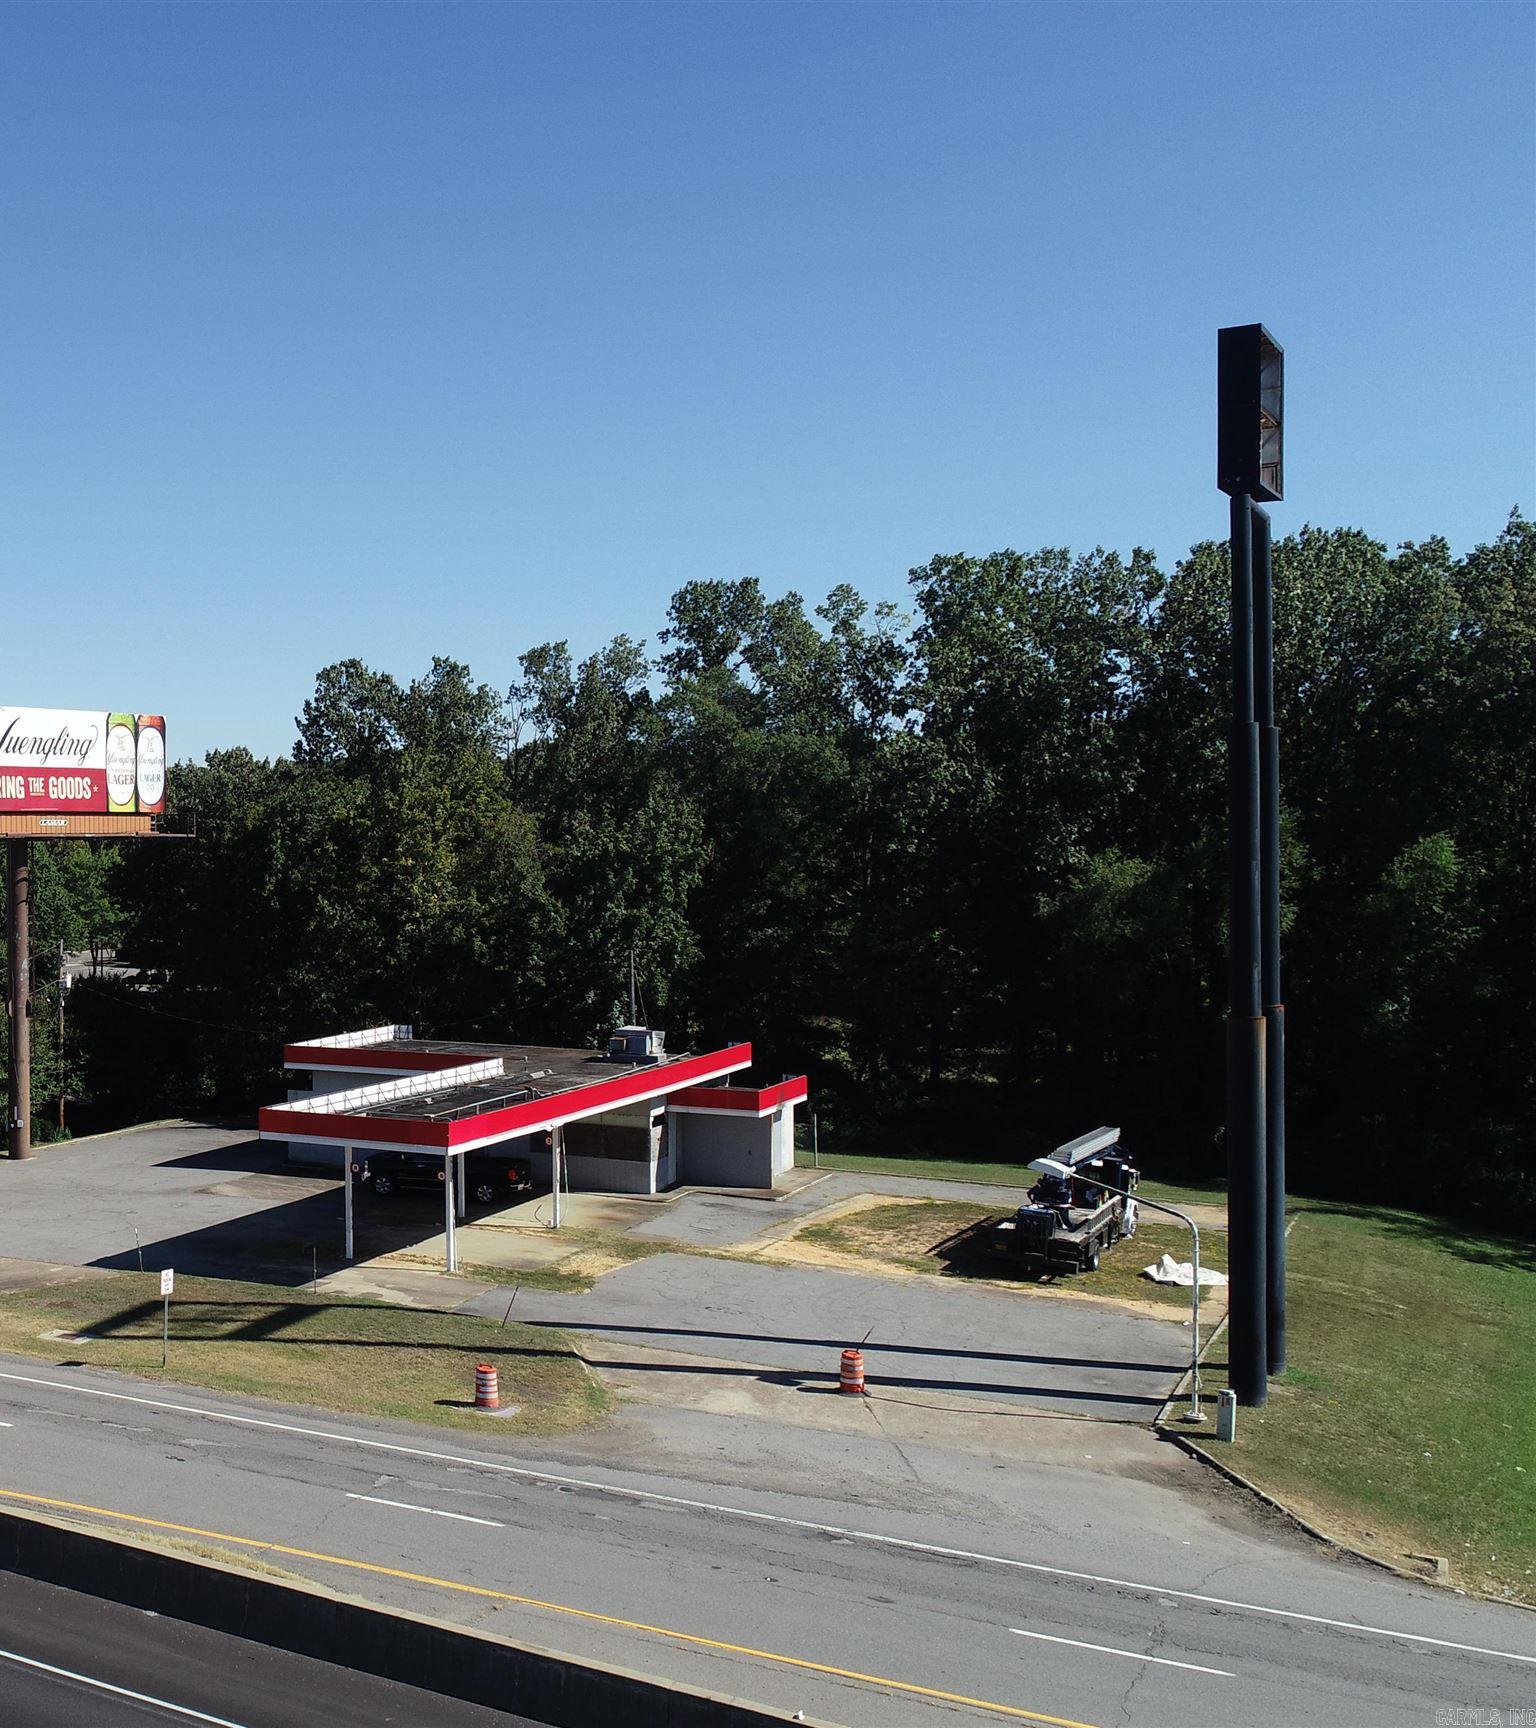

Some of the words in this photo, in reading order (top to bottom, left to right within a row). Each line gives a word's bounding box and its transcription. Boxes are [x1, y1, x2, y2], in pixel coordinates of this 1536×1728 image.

[28, 776, 45, 794] THE
[48, 776, 92, 800] GOODS
[107, 774, 135, 785] LAGER
